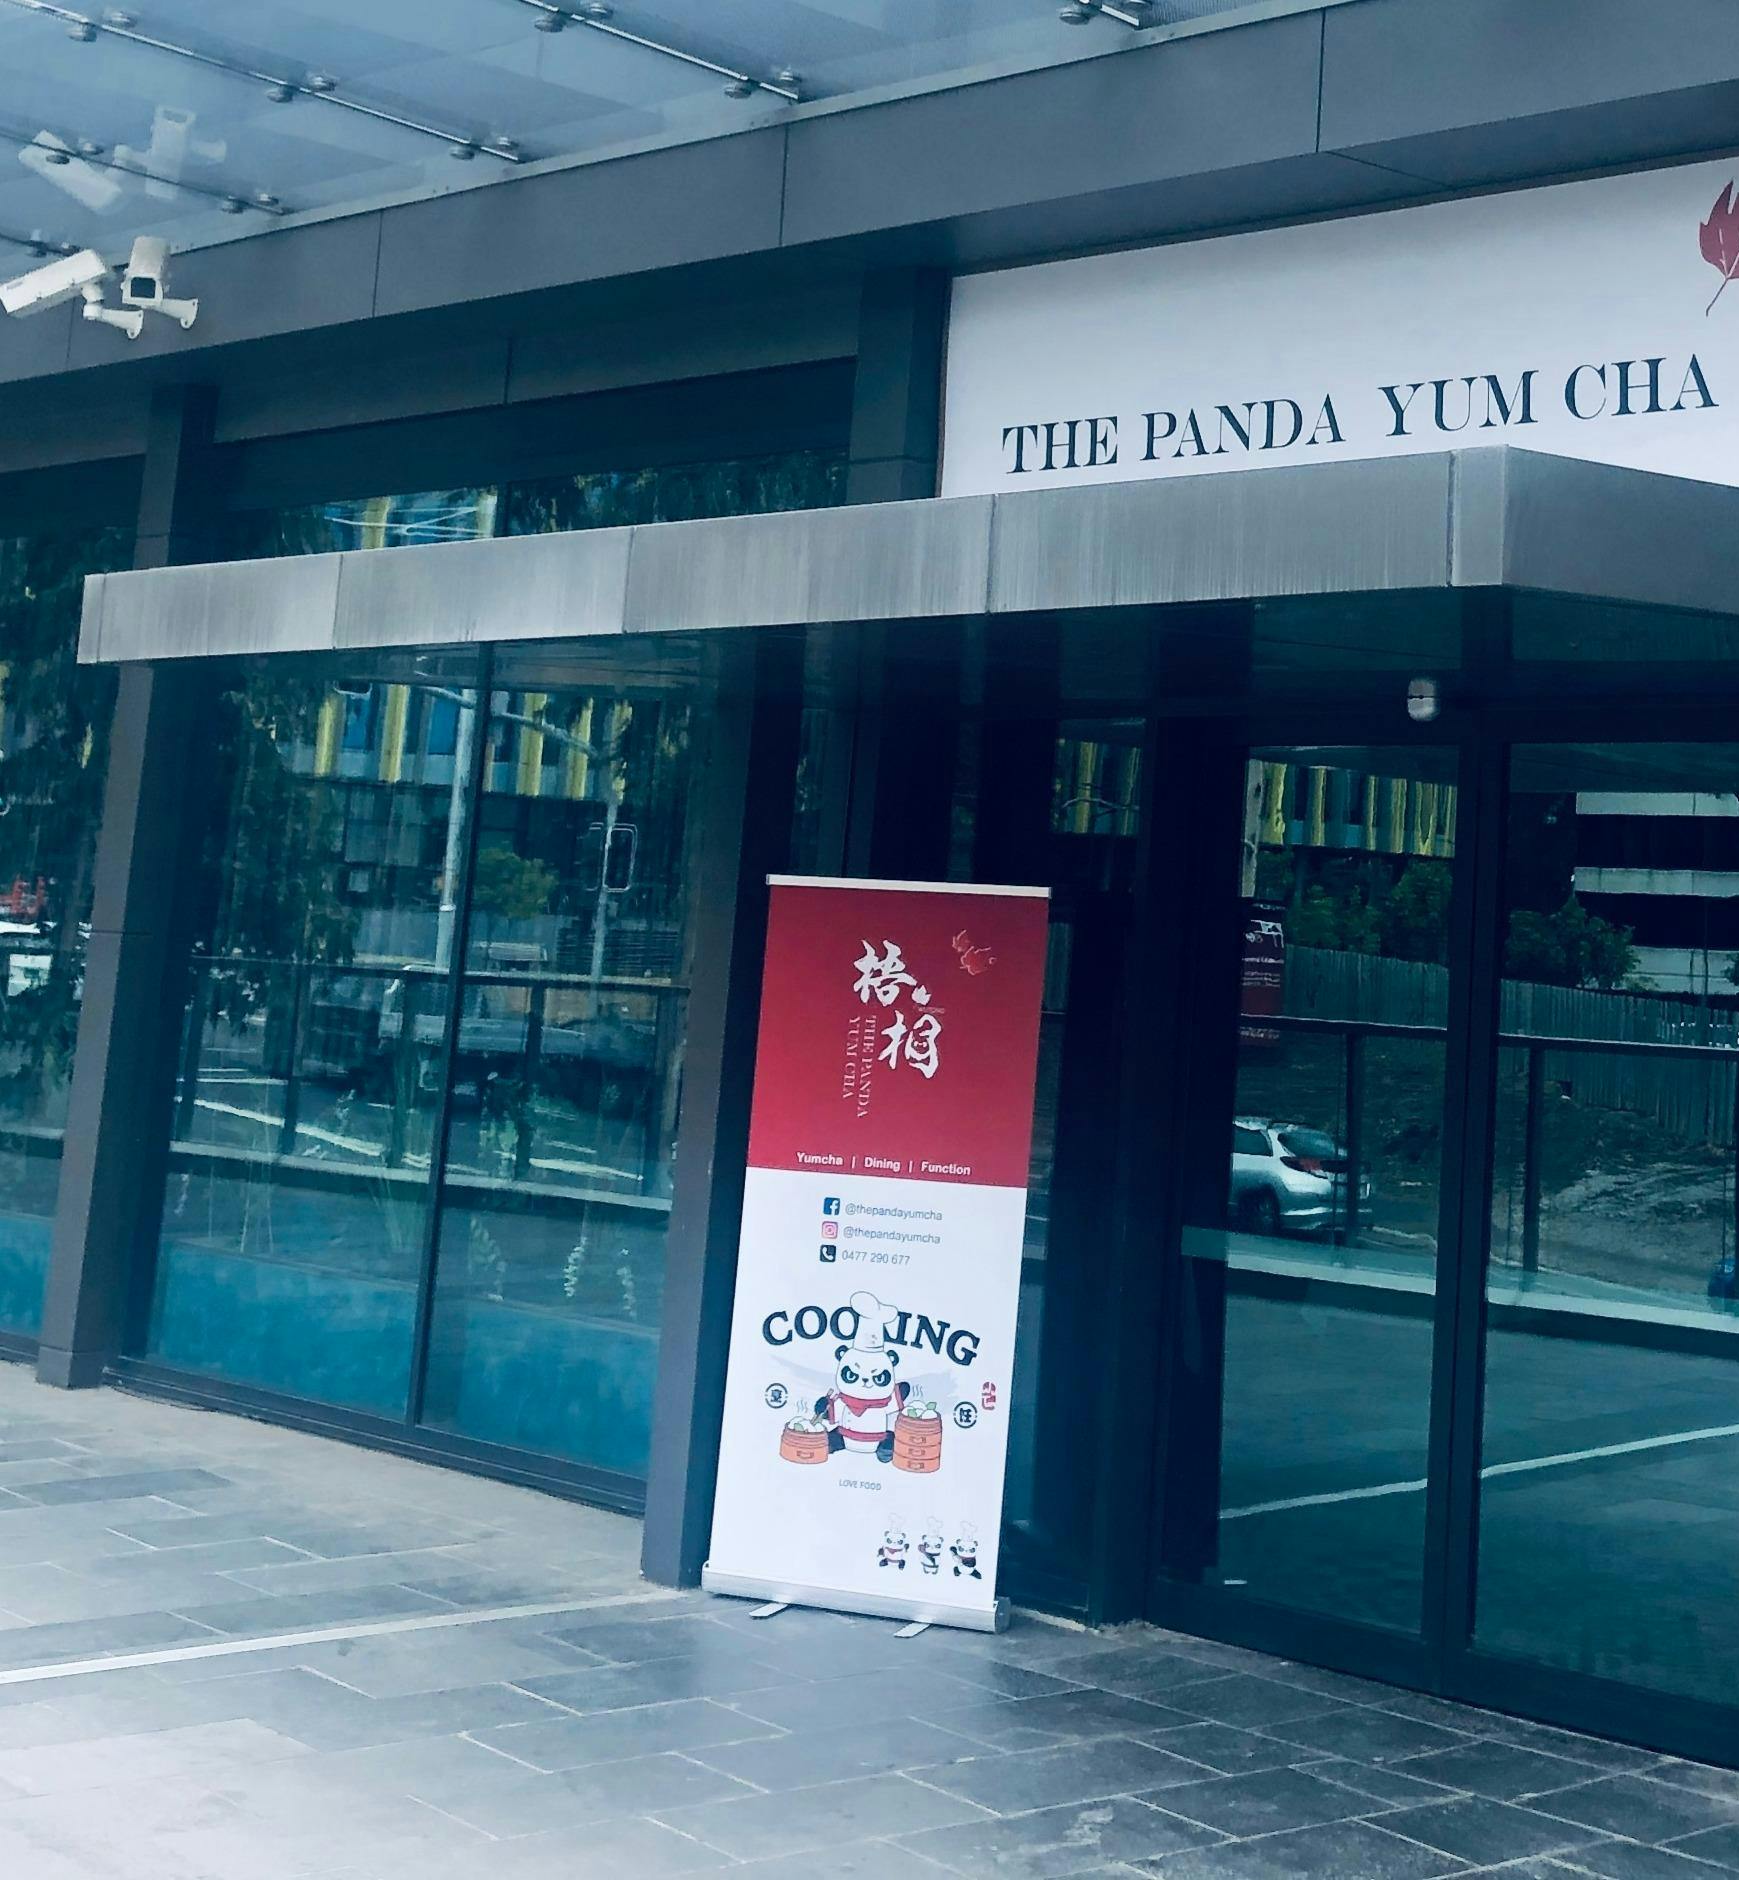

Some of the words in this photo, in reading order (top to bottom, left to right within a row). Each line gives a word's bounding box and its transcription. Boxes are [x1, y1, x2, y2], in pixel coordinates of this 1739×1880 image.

[1001, 415, 1119, 475] THE
[1139, 392, 1347, 462] PANDA
[1377, 369, 1540, 437] YUM
[1563, 353, 1720, 420] CHA
[846, 1016, 861, 1057] YUM
[863, 1014, 877, 1053] THE
[842, 1062, 857, 1099] CHA
[857, 1057, 874, 1118] PANDA
[796, 1151, 844, 1166] Yumcha
[864, 1156, 901, 1172] Dining
[920, 1161, 971, 1176] Function
[844, 1202, 943, 1222] @thepandayumcha
[842, 1225, 941, 1245] @thepandayumcha
[841, 1249, 867, 1261] 0477
[870, 1252, 889, 1264] 290
[891, 1254, 911, 1266] 677
[762, 1305, 981, 1367] COOING
